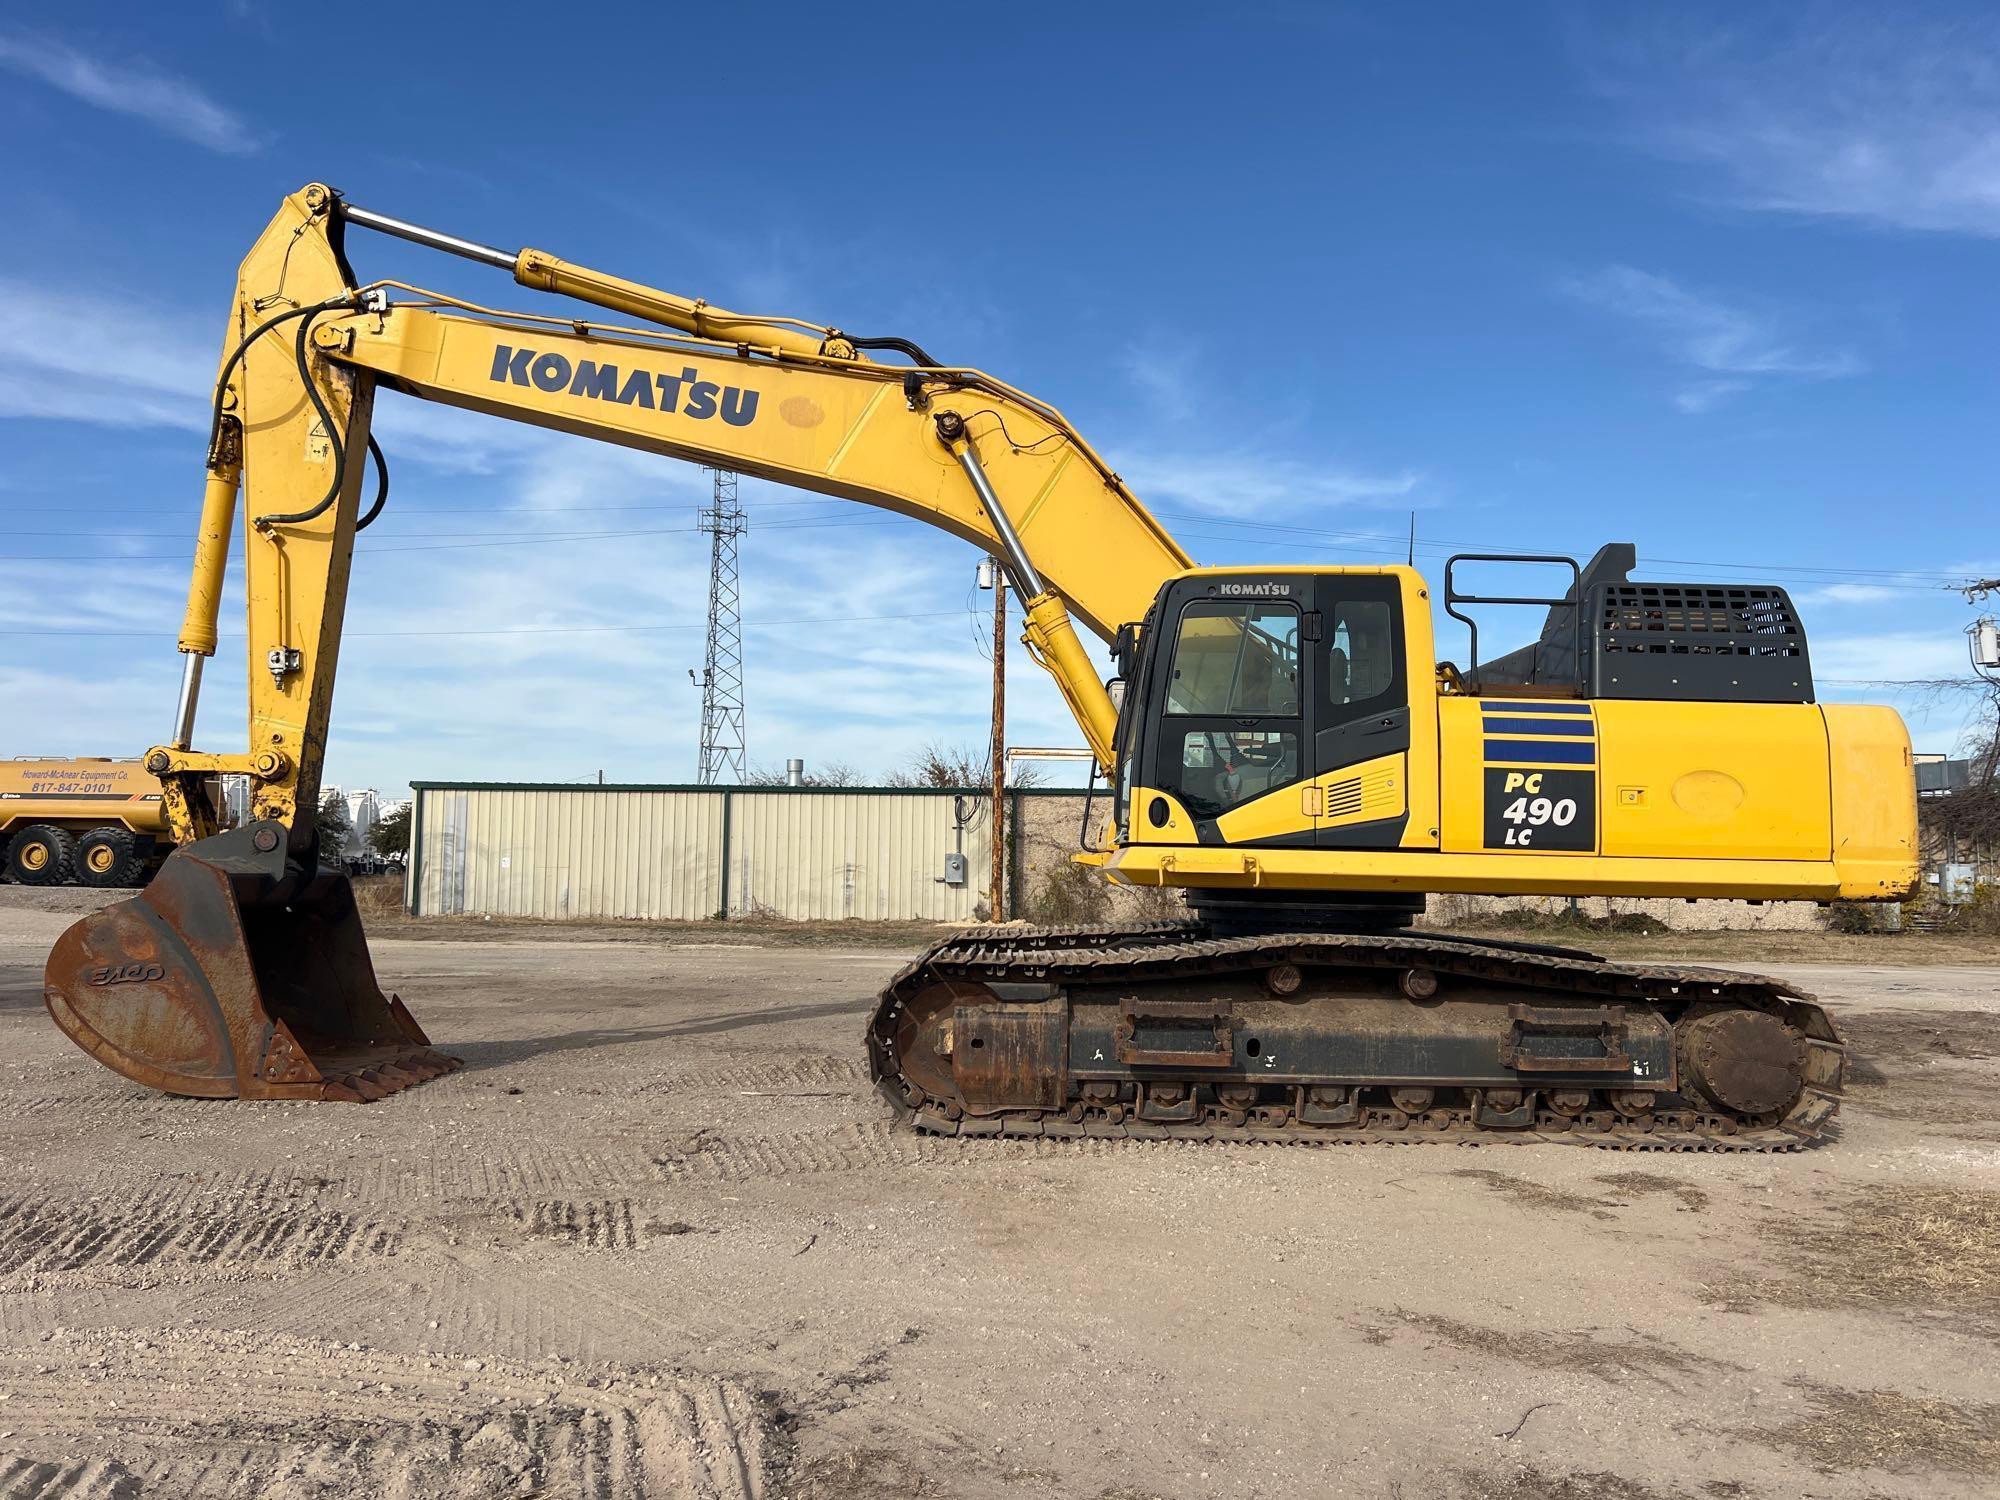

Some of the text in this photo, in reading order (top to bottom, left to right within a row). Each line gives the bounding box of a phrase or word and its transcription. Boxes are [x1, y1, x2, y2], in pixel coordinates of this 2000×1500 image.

[489, 344, 760, 426] KOMATSU
[1220, 582, 1290, 596] KOMATSU
[80, 770, 117, 782] Equipment
[1503, 772, 1543, 794] PC
[31, 782, 113, 793] 817-847-0101
[1502, 797, 1577, 827] 490
[1504, 828, 1533, 846] LC
